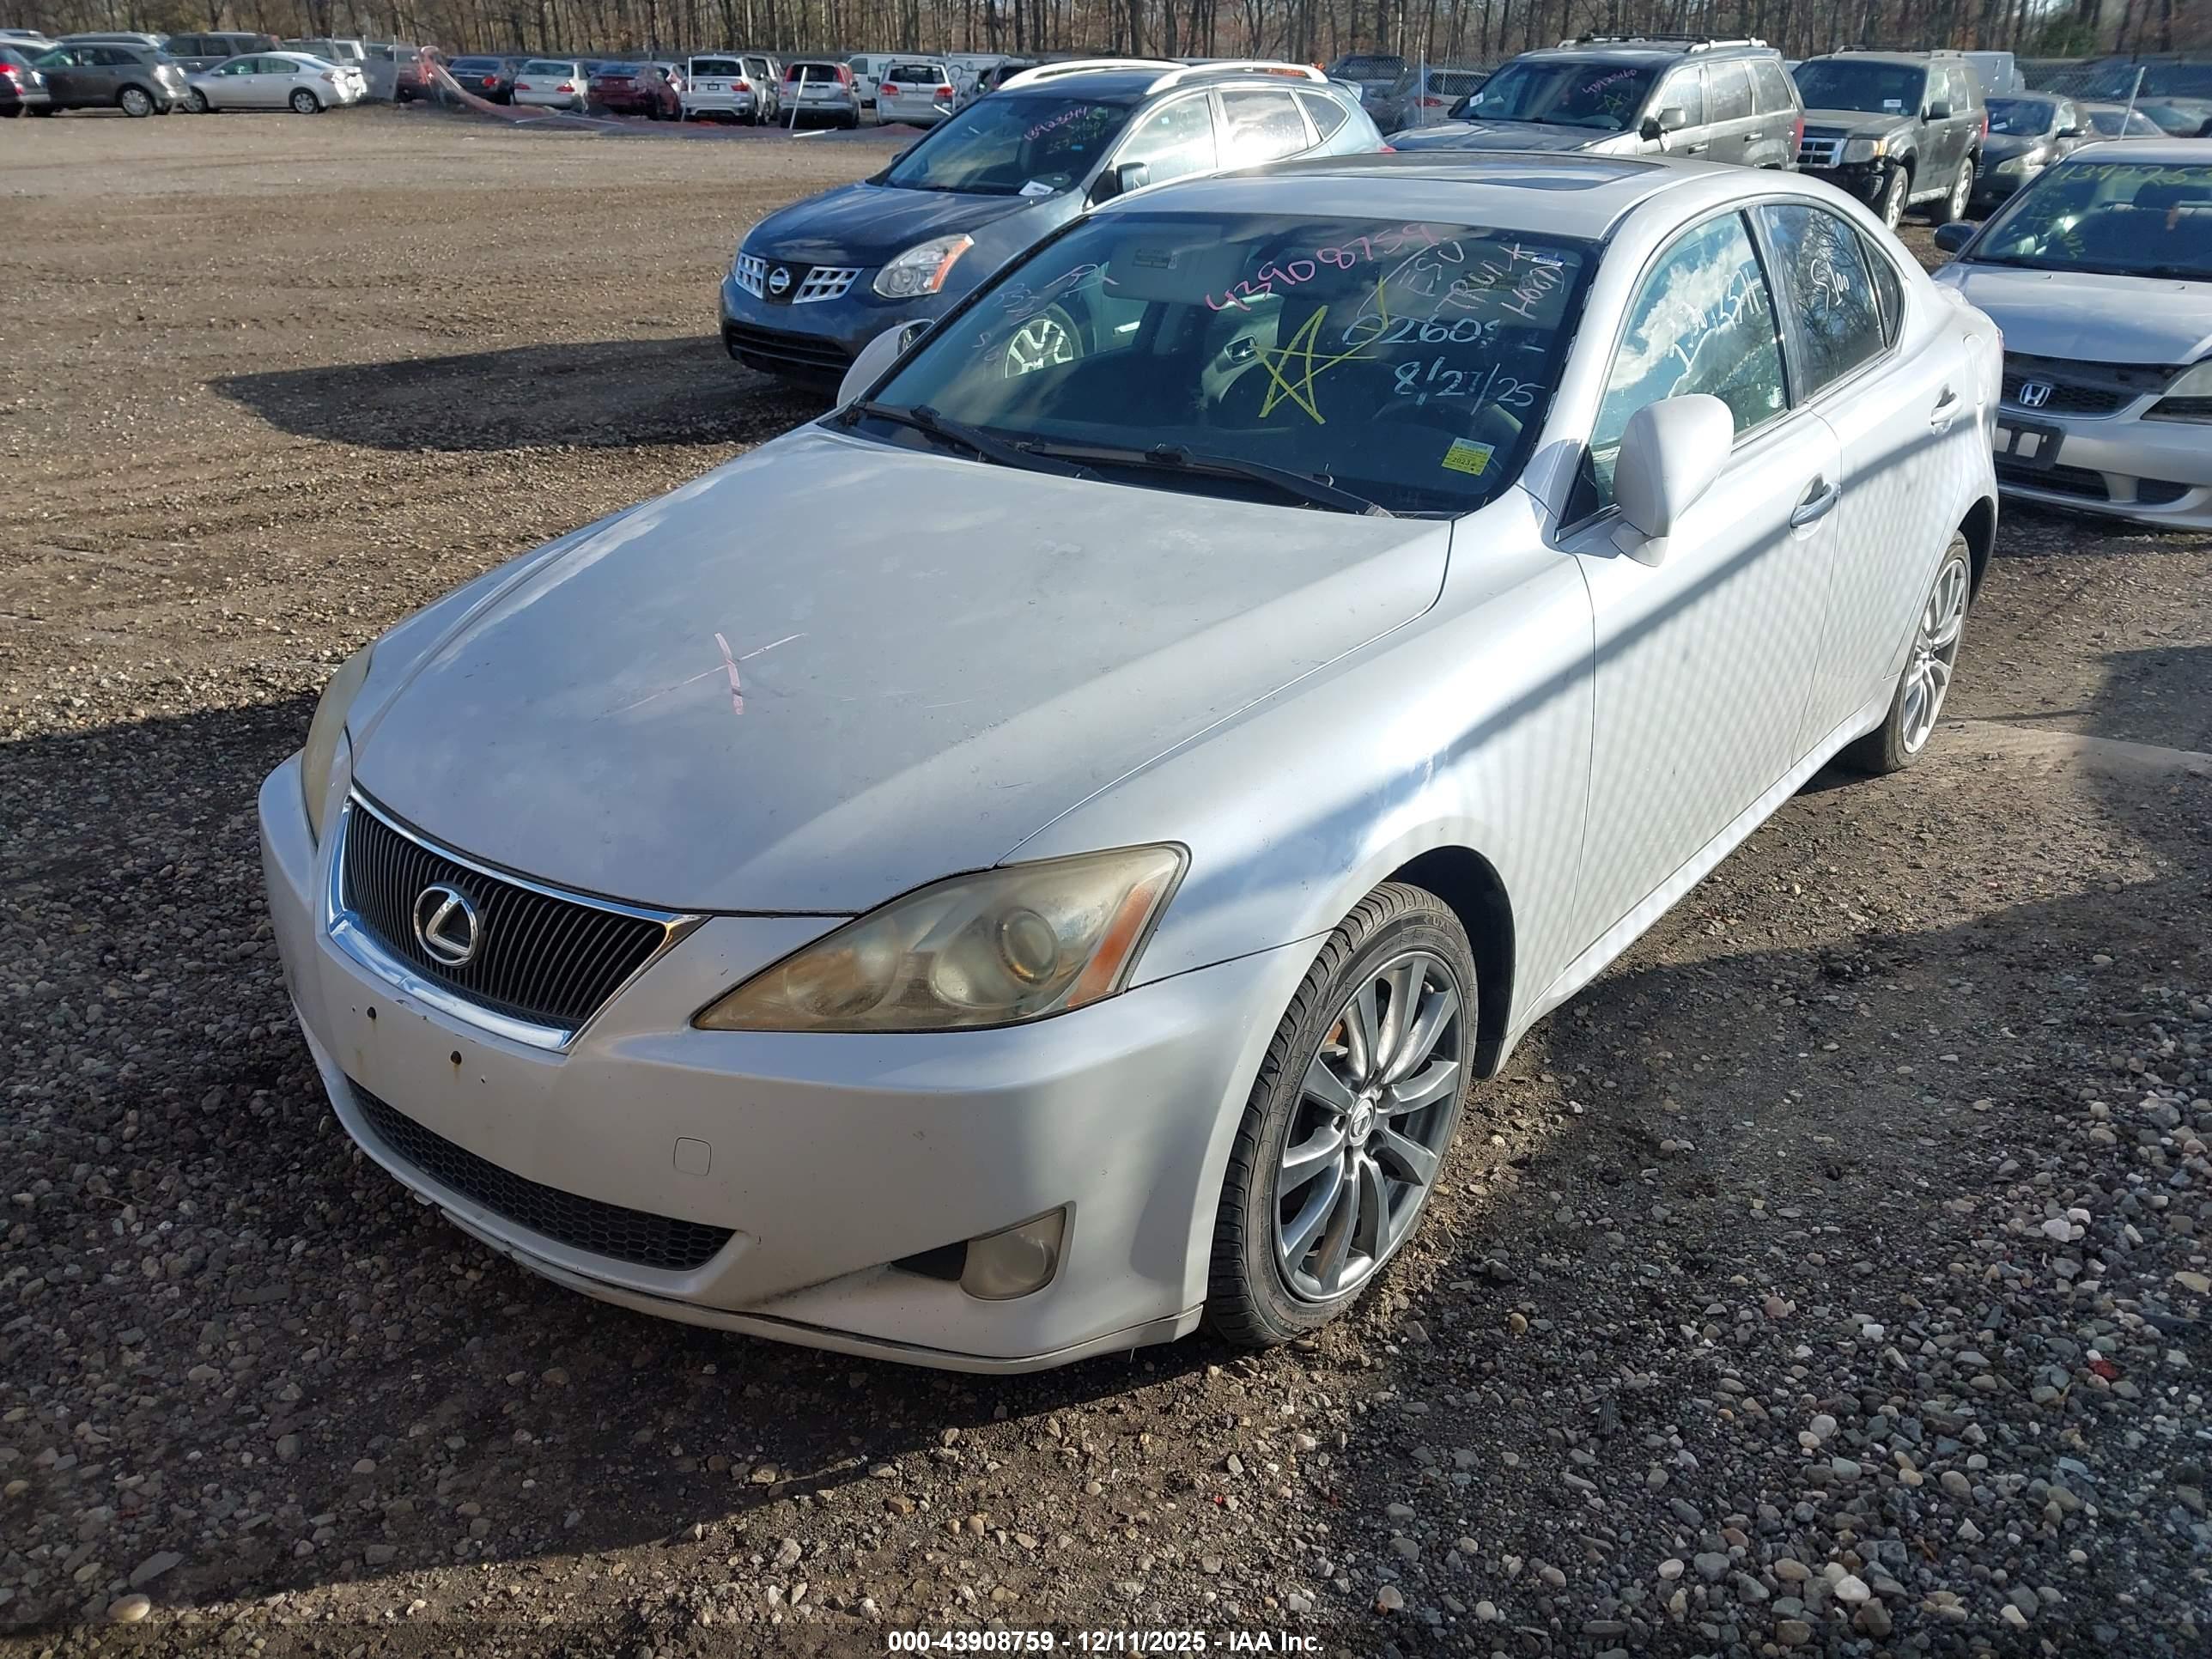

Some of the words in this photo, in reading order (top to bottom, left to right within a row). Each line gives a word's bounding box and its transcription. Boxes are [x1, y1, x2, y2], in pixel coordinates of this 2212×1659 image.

[1206, 223, 1439, 312] 43908759
[1435, 242, 1535, 313] TRUNK
[1394, 356, 1547, 416] 8/27/25
